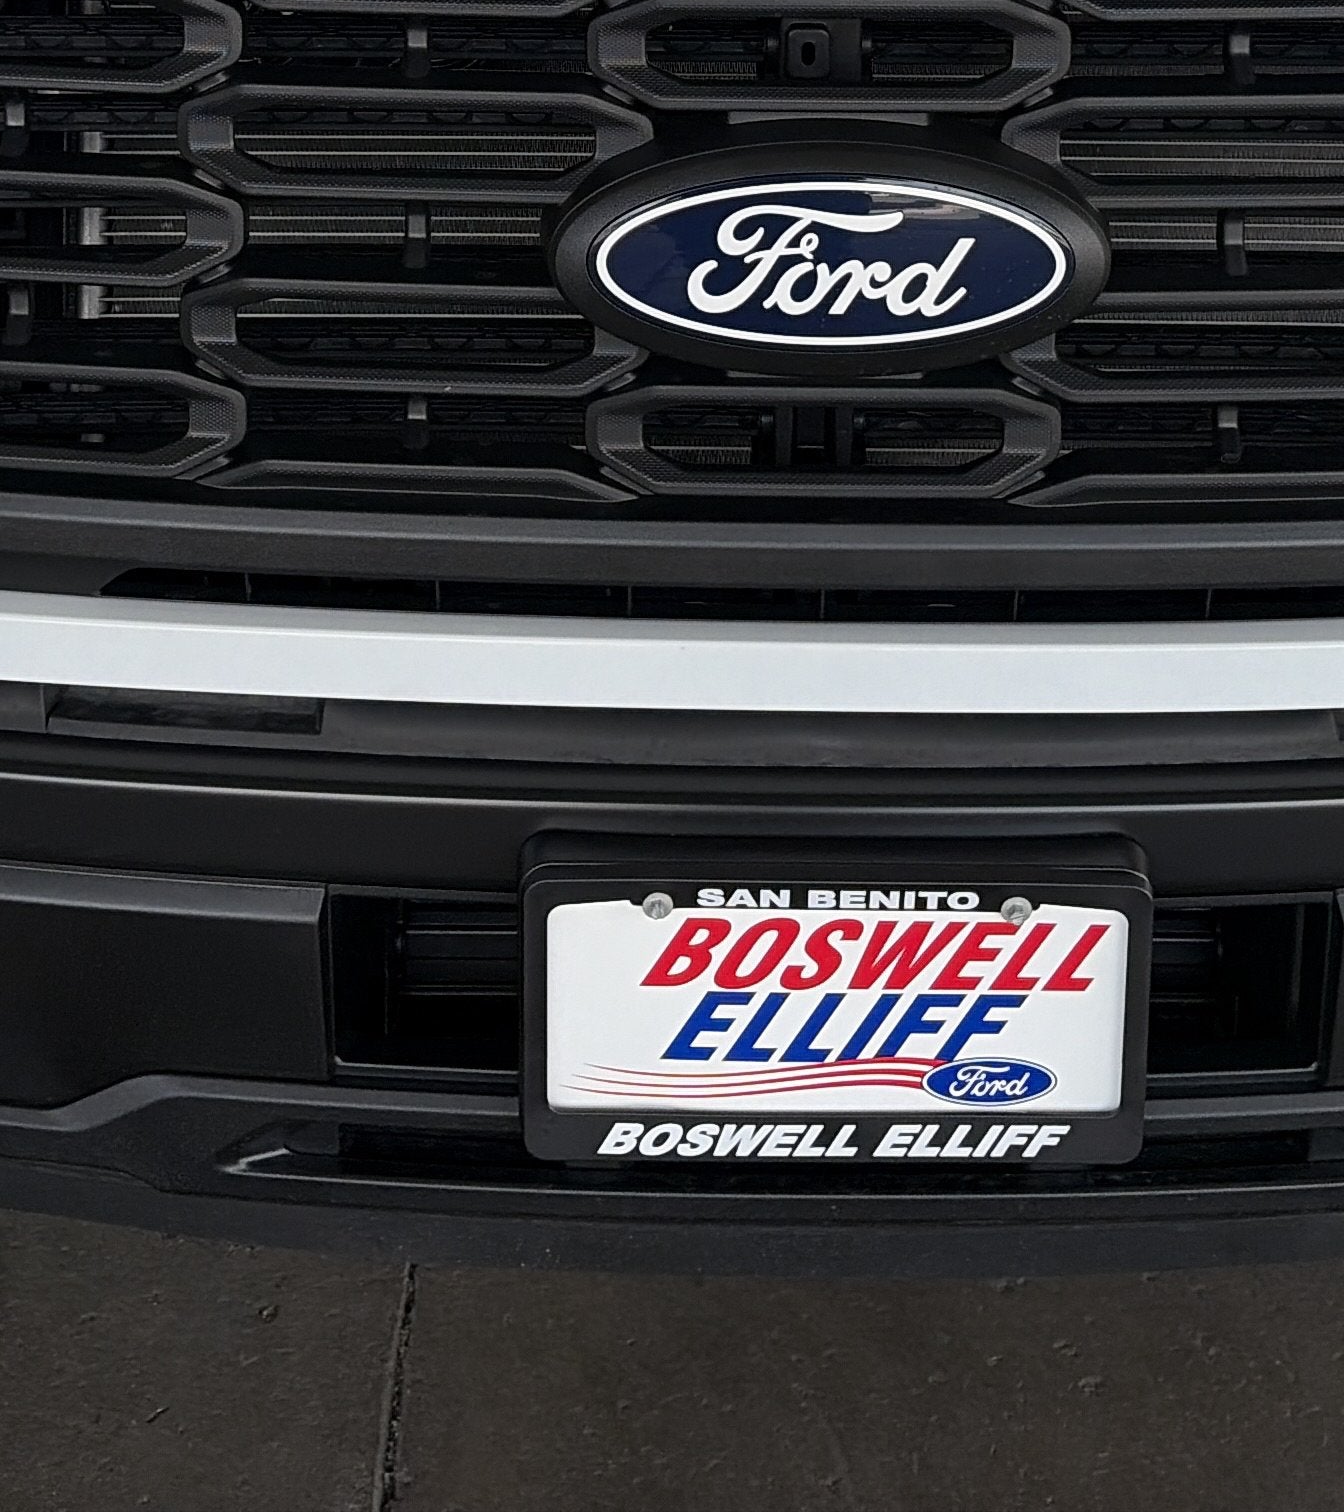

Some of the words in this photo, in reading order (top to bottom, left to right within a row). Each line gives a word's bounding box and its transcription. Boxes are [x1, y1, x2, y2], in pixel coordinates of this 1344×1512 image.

[687, 204, 976, 317] Ford
[696, 888, 794, 910] SAN
[807, 889, 980, 911] BENITO
[639, 916, 1112, 992] BOSWELL
[659, 991, 1029, 1063] ELLIFF
[948, 1065, 1029, 1097] Ford
[596, 1122, 859, 1158] BOSWELL
[872, 1124, 1071, 1159] ELLIFF
